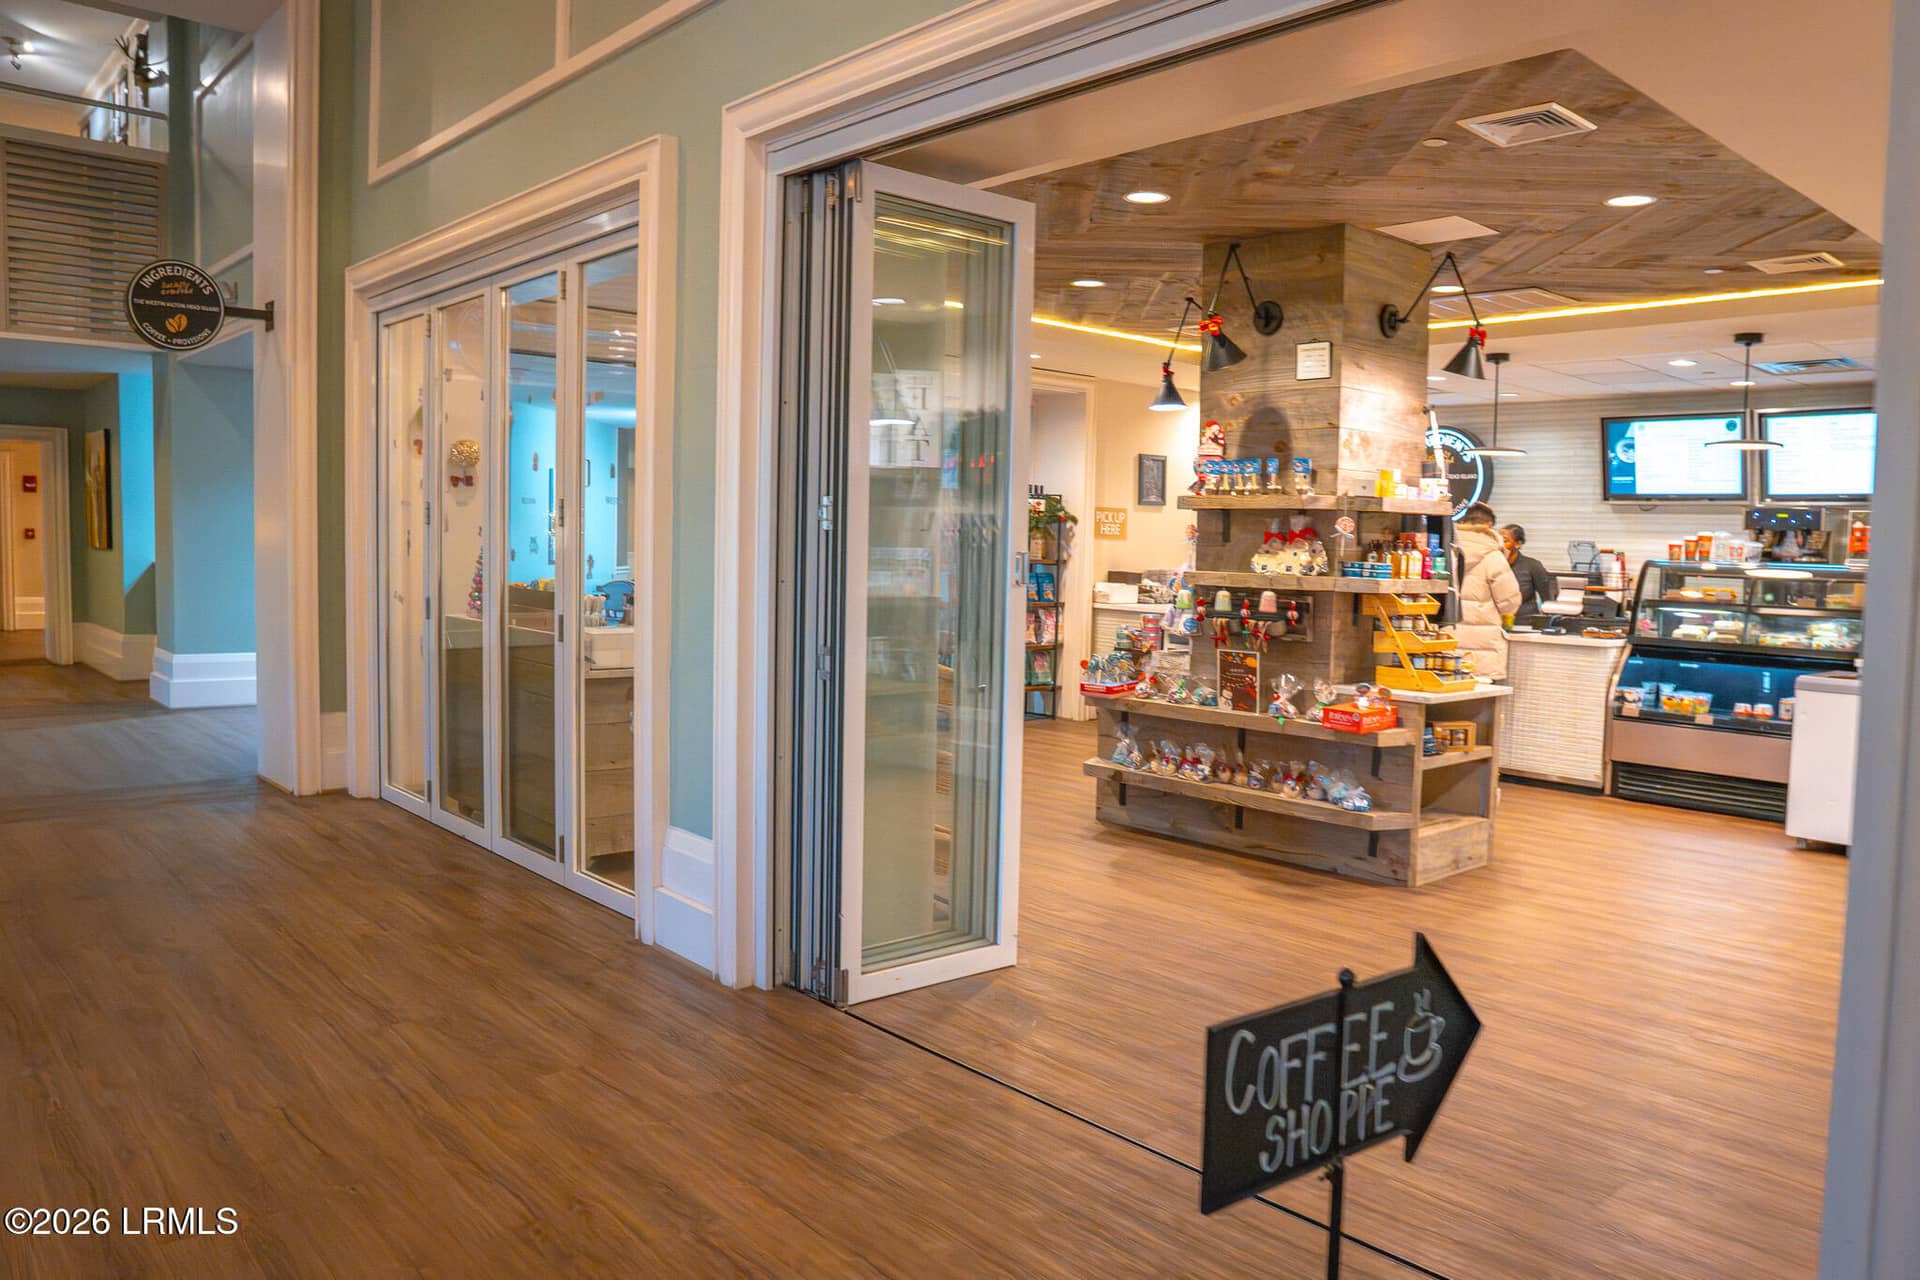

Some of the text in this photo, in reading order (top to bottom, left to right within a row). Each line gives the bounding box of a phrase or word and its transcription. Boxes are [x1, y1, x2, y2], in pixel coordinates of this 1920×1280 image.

[139, 265, 214, 296] INGREDIENTS
[142, 322, 167, 343] COFFEE
[1095, 511, 1126, 523] PICK UP
[1100, 523, 1121, 535] HERE
[1225, 1001, 1397, 1115] COFFEE
